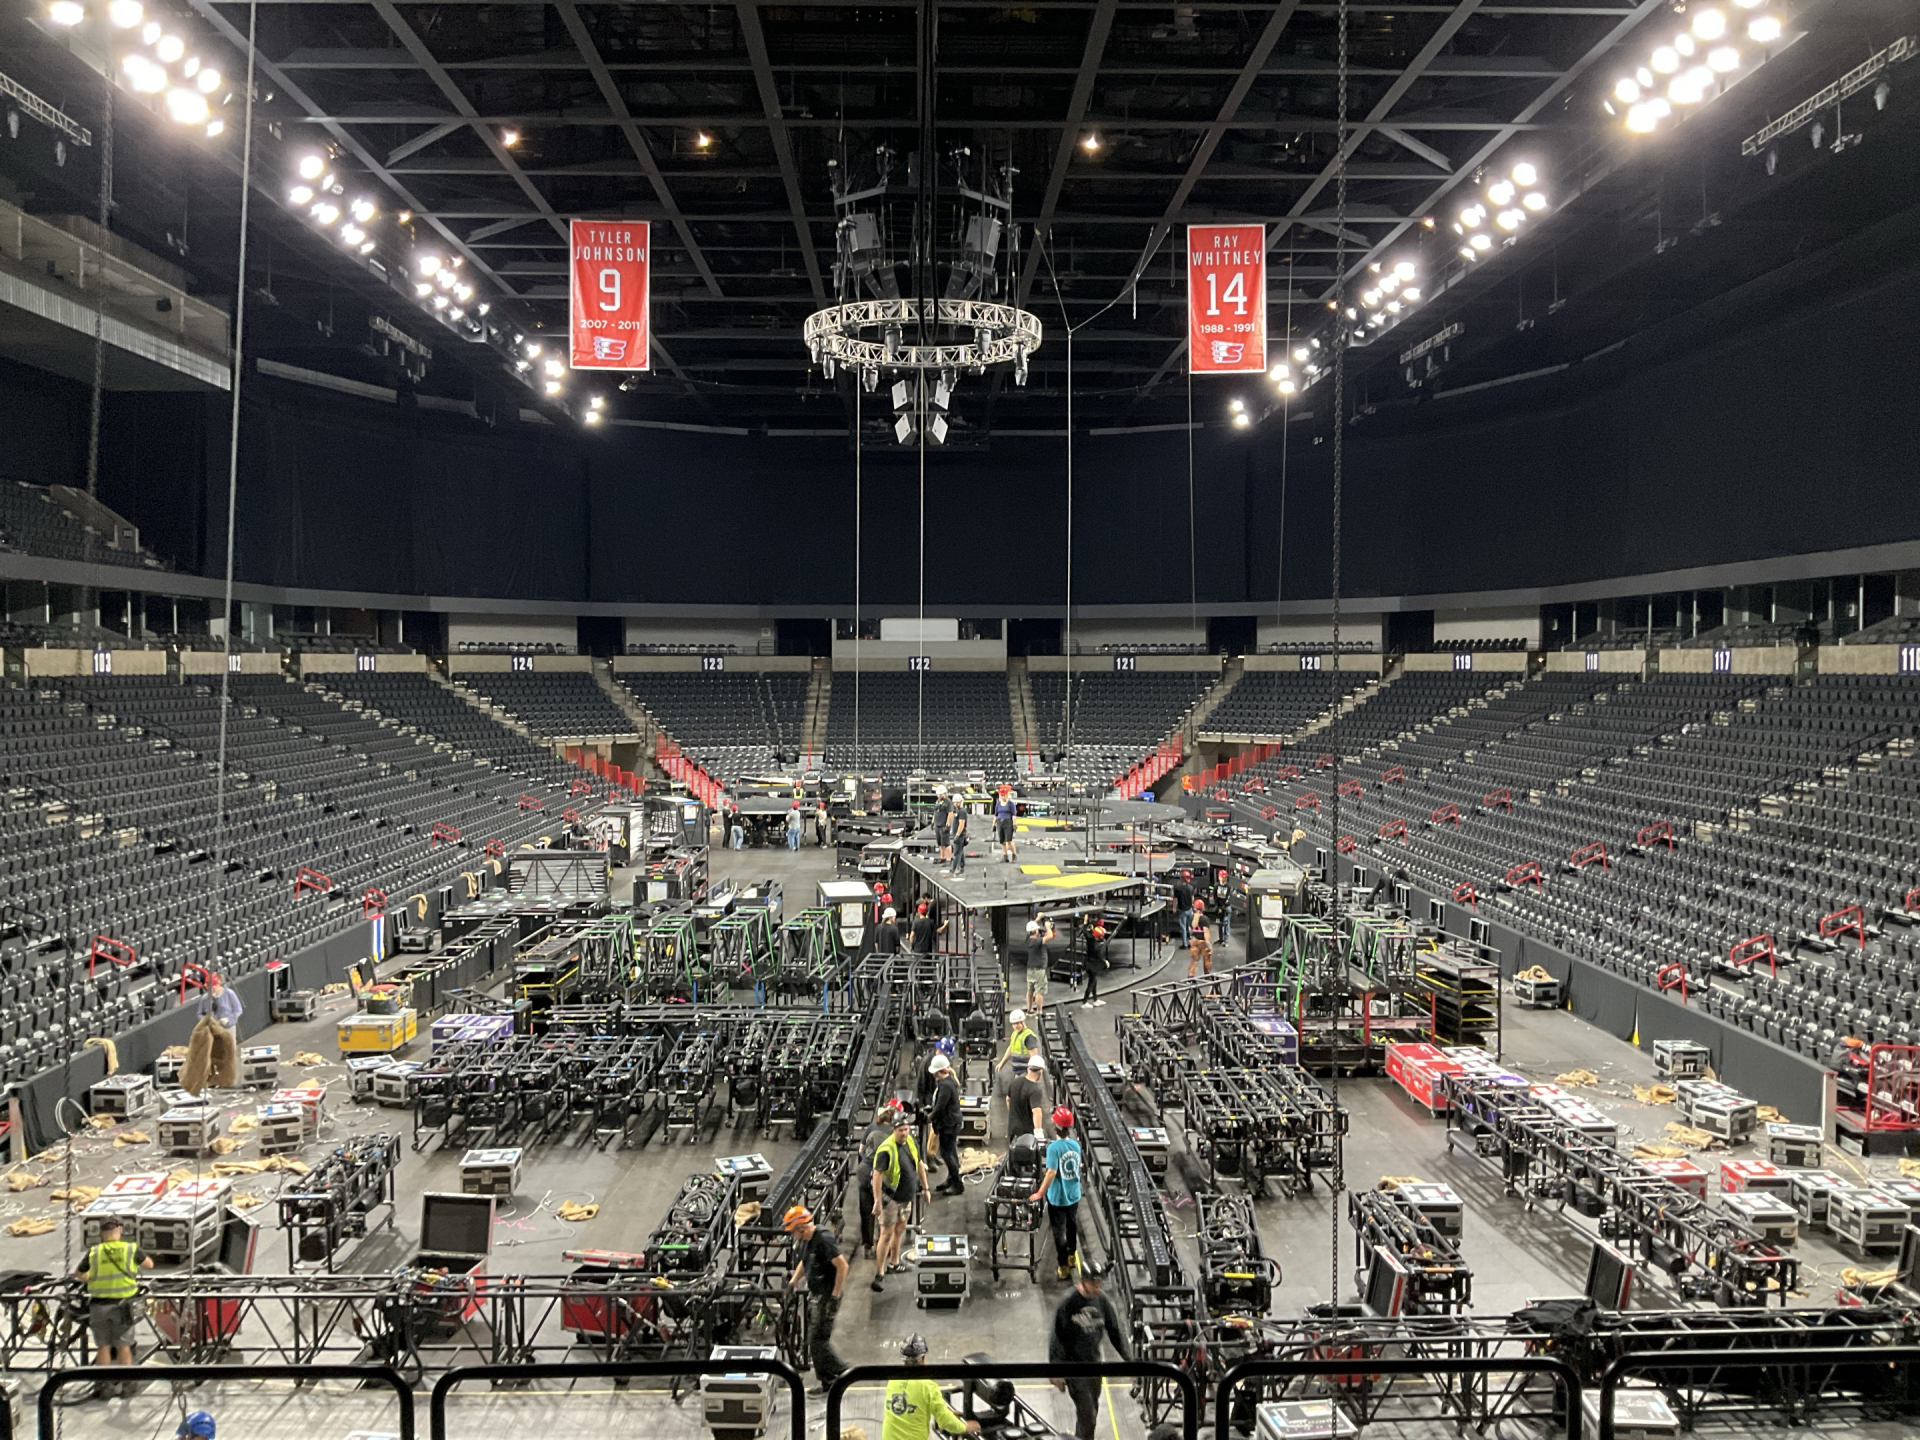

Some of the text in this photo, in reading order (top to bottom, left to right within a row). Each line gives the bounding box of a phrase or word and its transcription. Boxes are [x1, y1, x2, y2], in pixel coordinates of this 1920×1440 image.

[590, 230, 631, 244] TYLER
[1214, 235, 1239, 248] RAY
[576, 246, 645, 262] JOHNSON
[1192, 250, 1261, 266] WHITNEY
[599, 268, 621, 312] 9
[1206, 272, 1248, 316] 14
[581, 319, 608, 329] 2007
[618, 321, 640, 330] 2011
[1200, 324, 1224, 333] 1988
[1233, 323, 1255, 333] 1991
[94, 652, 111, 673] 103
[228, 655, 241, 671] 102
[358, 656, 375, 671] 101
[513, 657, 533, 670] 124
[703, 657, 723, 670] 123
[910, 657, 930, 670] 122
[1116, 657, 1134, 670] 121
[1301, 656, 1320, 670] 120
[1455, 655, 1471, 670] 119
[1714, 651, 1730, 671] 117
